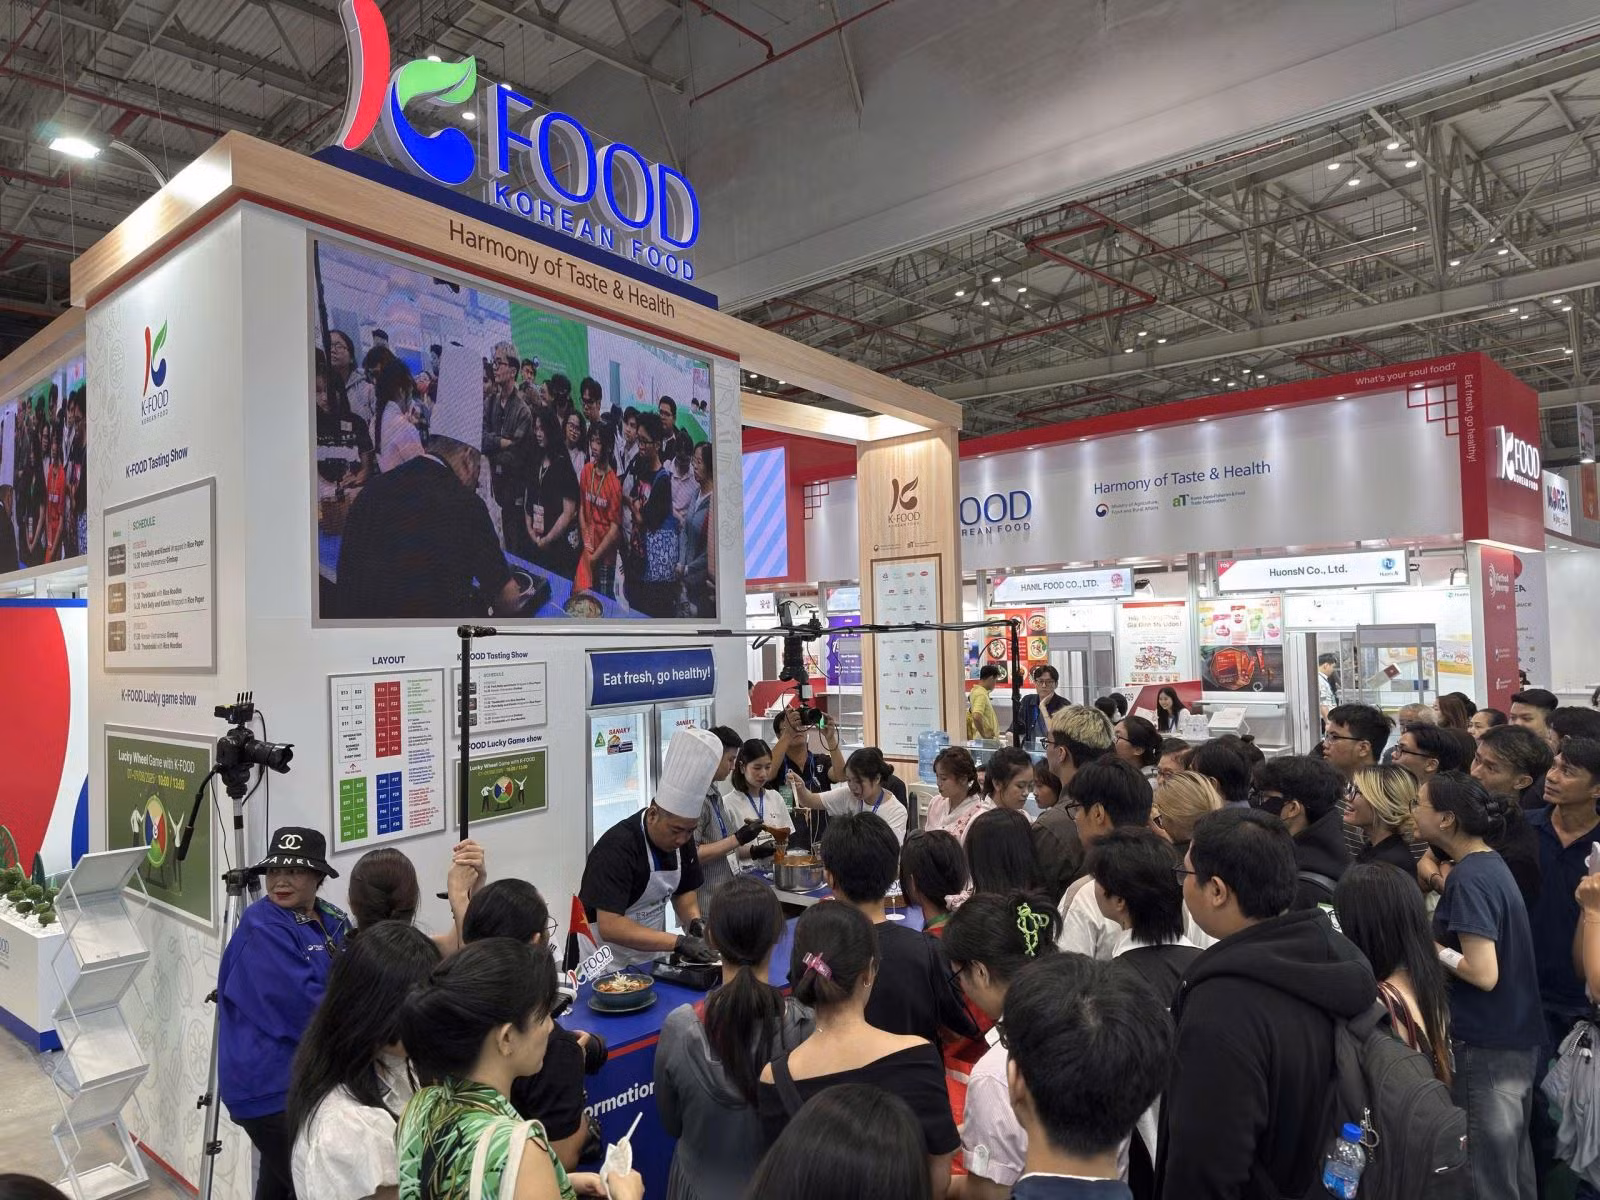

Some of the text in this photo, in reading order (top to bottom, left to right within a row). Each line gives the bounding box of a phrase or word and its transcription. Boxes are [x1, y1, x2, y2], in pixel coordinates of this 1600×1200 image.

[495, 83, 701, 251] FOOD
[493, 182, 695, 281] KOREAN FOOD
[449, 219, 676, 318] Harmony of Taste & Health
[1355, 362, 1456, 386] What's your soul food?
[1464, 374, 1474, 389] Eat
[141, 389, 169, 417] K-FOOD
[1464, 415, 1474, 427] go
[1466, 428, 1478, 462] healthy!
[125, 446, 189, 479] K-FOOD Tasting Show
[1514, 438, 1540, 480] FOOD
[1093, 461, 1271, 495] Harmony of Taste & Health
[959, 490, 1032, 526] OOD
[132, 516, 156, 531] SCHEDULE
[961, 522, 1031, 537] REAN FOOD
[1269, 563, 1348, 577] HuonsN Co., Ltd.
[1020, 579, 1100, 592] HANIL FOOD CO., LTD.
[372, 655, 406, 665] LAYOUT
[456, 651, 529, 661] KOOD Tasting Show
[603, 666, 711, 686] Eat fresh, go healthy!
[121, 688, 197, 707] K-FOOD Lucky game show
[608, 727, 631, 736] SANAKY
[457, 734, 542, 752] KOOD Lucky Game show
[118, 749, 195, 774] Lucky Wheel Game with K-FOOD
[254, 856, 314, 868] ANEL
[582, 946, 611, 974] FOOD
